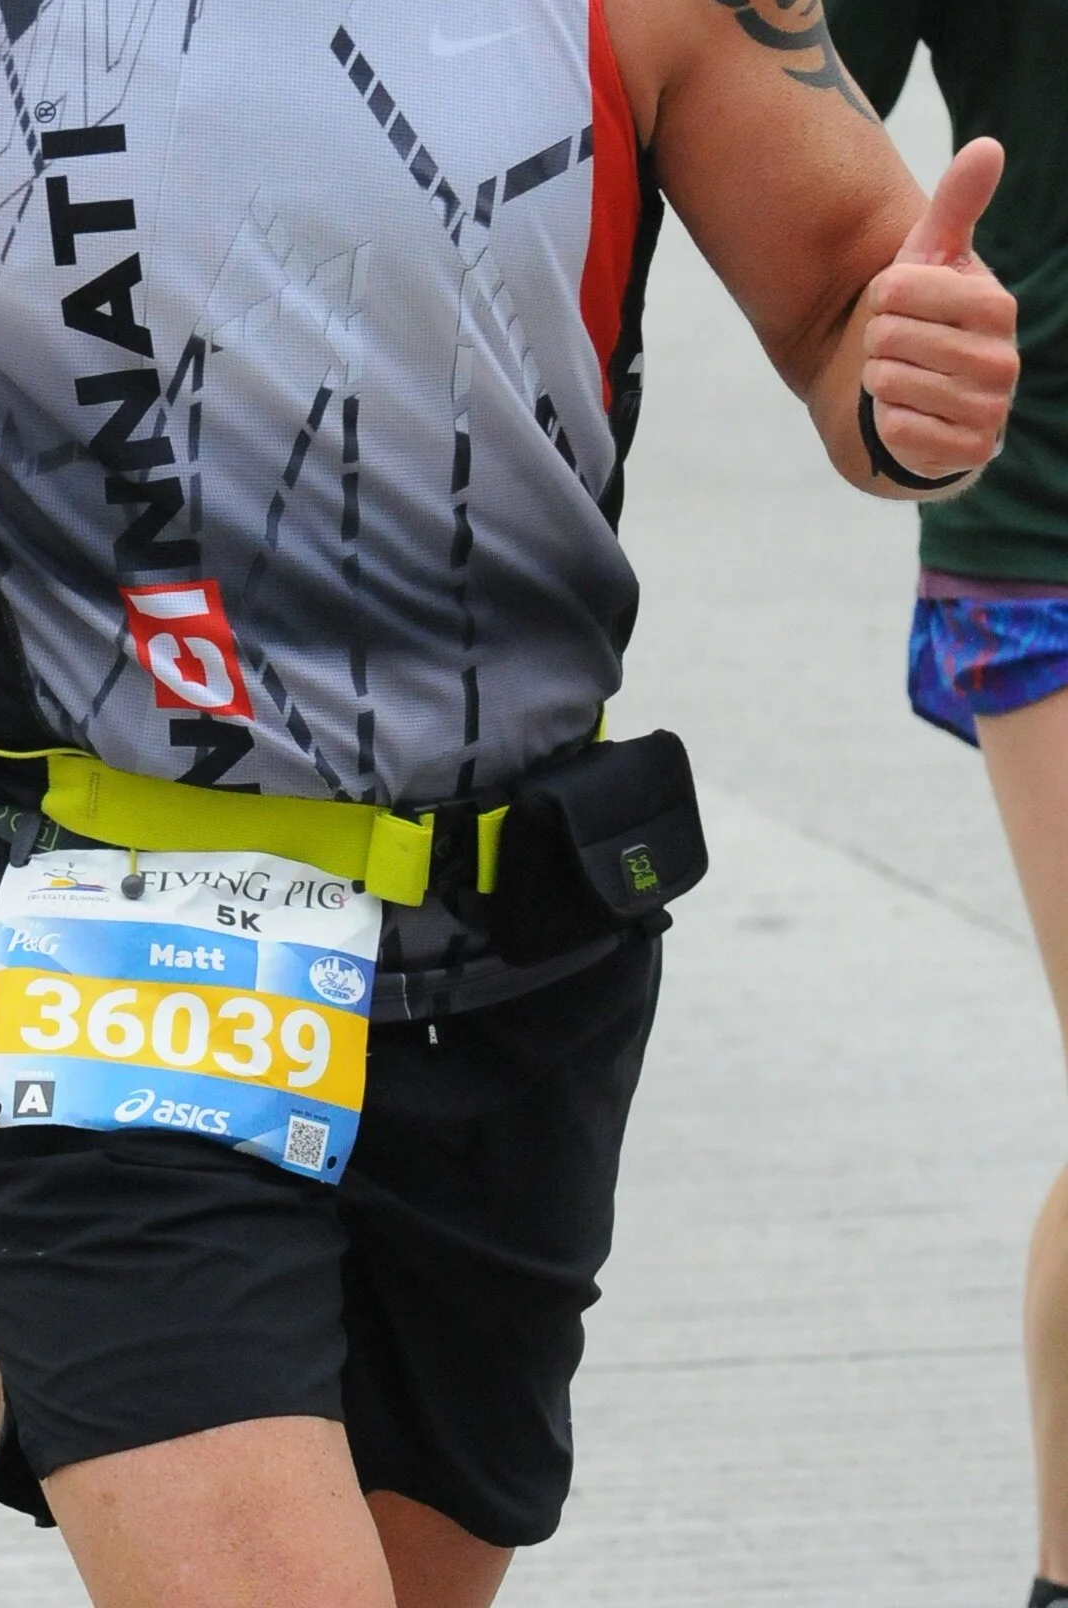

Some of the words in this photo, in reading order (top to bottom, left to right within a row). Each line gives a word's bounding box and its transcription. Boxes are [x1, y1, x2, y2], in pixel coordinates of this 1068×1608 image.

[139, 871, 271, 902] FLYING
[283, 879, 347, 910] PIG
[216, 904, 263, 933] 5K
[5, 927, 62, 955] P&G
[149, 943, 226, 971] Matt
[20, 978, 331, 1087] 36039
[17, 1084, 48, 1113] A
